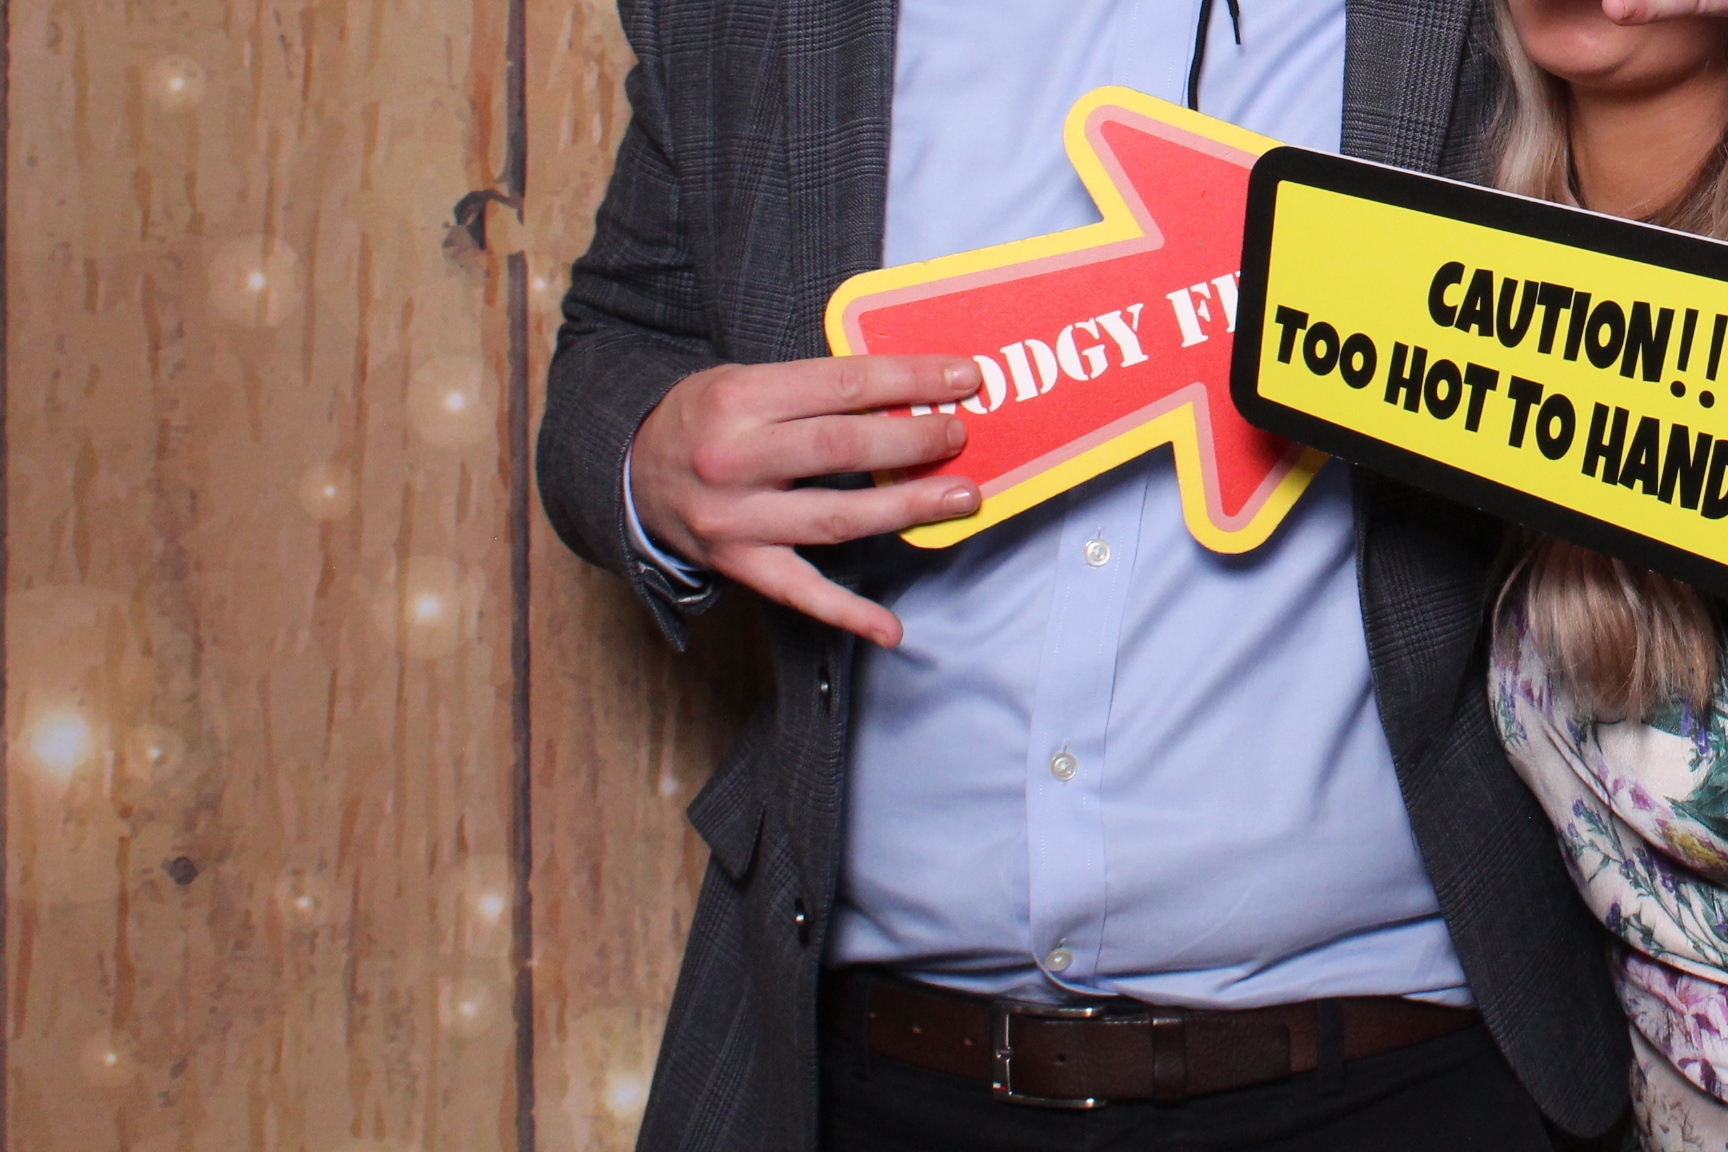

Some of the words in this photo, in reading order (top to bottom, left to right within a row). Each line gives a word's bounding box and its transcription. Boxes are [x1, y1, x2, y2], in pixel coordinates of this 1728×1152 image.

[911, 302, 1149, 417] ODGY
[1275, 304, 1378, 390] TOO
[1384, 341, 1499, 433] HOT
[1508, 374, 1576, 461] TO
